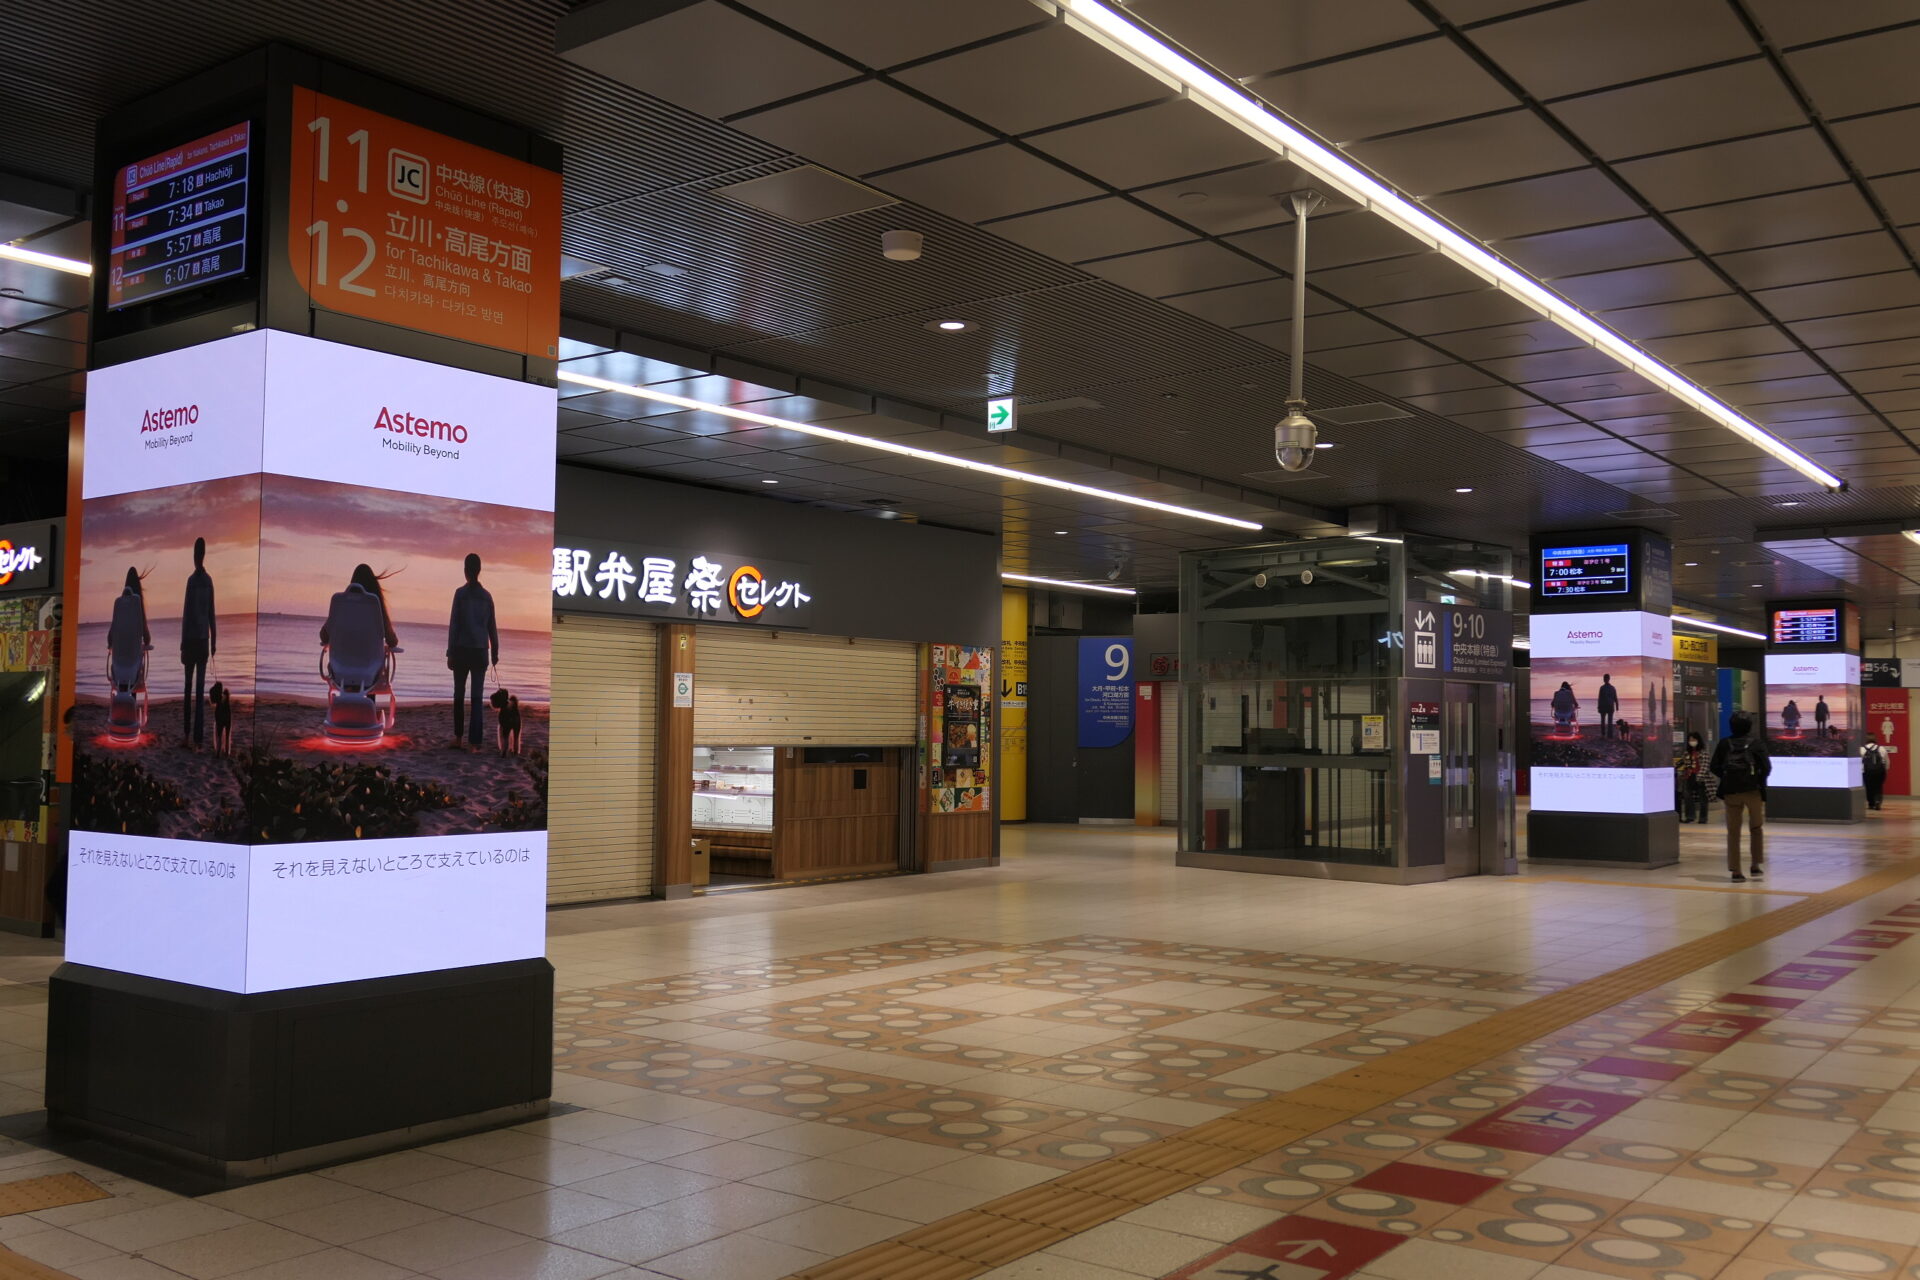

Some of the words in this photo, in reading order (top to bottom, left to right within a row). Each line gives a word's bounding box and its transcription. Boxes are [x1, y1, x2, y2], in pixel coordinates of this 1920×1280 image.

[307, 116, 369, 194] 11
[169, 176, 194, 198] 7:18
[205, 164, 233, 184] Hachiōji
[397, 165, 421, 188] JC
[436, 163, 531, 209] 中央線(快速)
[168, 203, 193, 227] 7:34
[204, 198, 225, 212] Takao
[435, 185, 463, 202] Chūō
[465, 194, 486, 209] Line
[488, 202, 523, 222] (Rapid)
[113, 213, 124, 232] 11
[166, 235, 191, 257] 5:57
[202, 226, 222, 245] 高尾
[385, 210, 532, 274] 立川・高尾方面
[165, 263, 190, 285] 6:07
[201, 255, 220, 275] 高尾
[305, 219, 377, 298] 12
[386, 242, 406, 259] for
[409, 248, 479, 281] Tachikawa
[482, 268, 492, 283] &
[495, 271, 532, 294] Takao
[112, 267, 123, 286] 12
[140, 404, 199, 434] Astemo
[373, 406, 468, 444] Astemo
[144, 436, 168, 450] Mobility
[169, 432, 193, 449] Beyond
[382, 437, 422, 456] Mobility
[423, 444, 460, 460] Beyond
[552, 547, 677, 604] 駅弁屋
[737, 576, 811, 609] セレクト
[1549, 568, 1568, 577] 7:00
[1567, 630, 1603, 639] Astemo
[1104, 643, 1130, 681] 9
[79, 846, 237, 880] それを見えないところで支えているのは
[272, 847, 531, 879] それを見えないところで支えているのは
